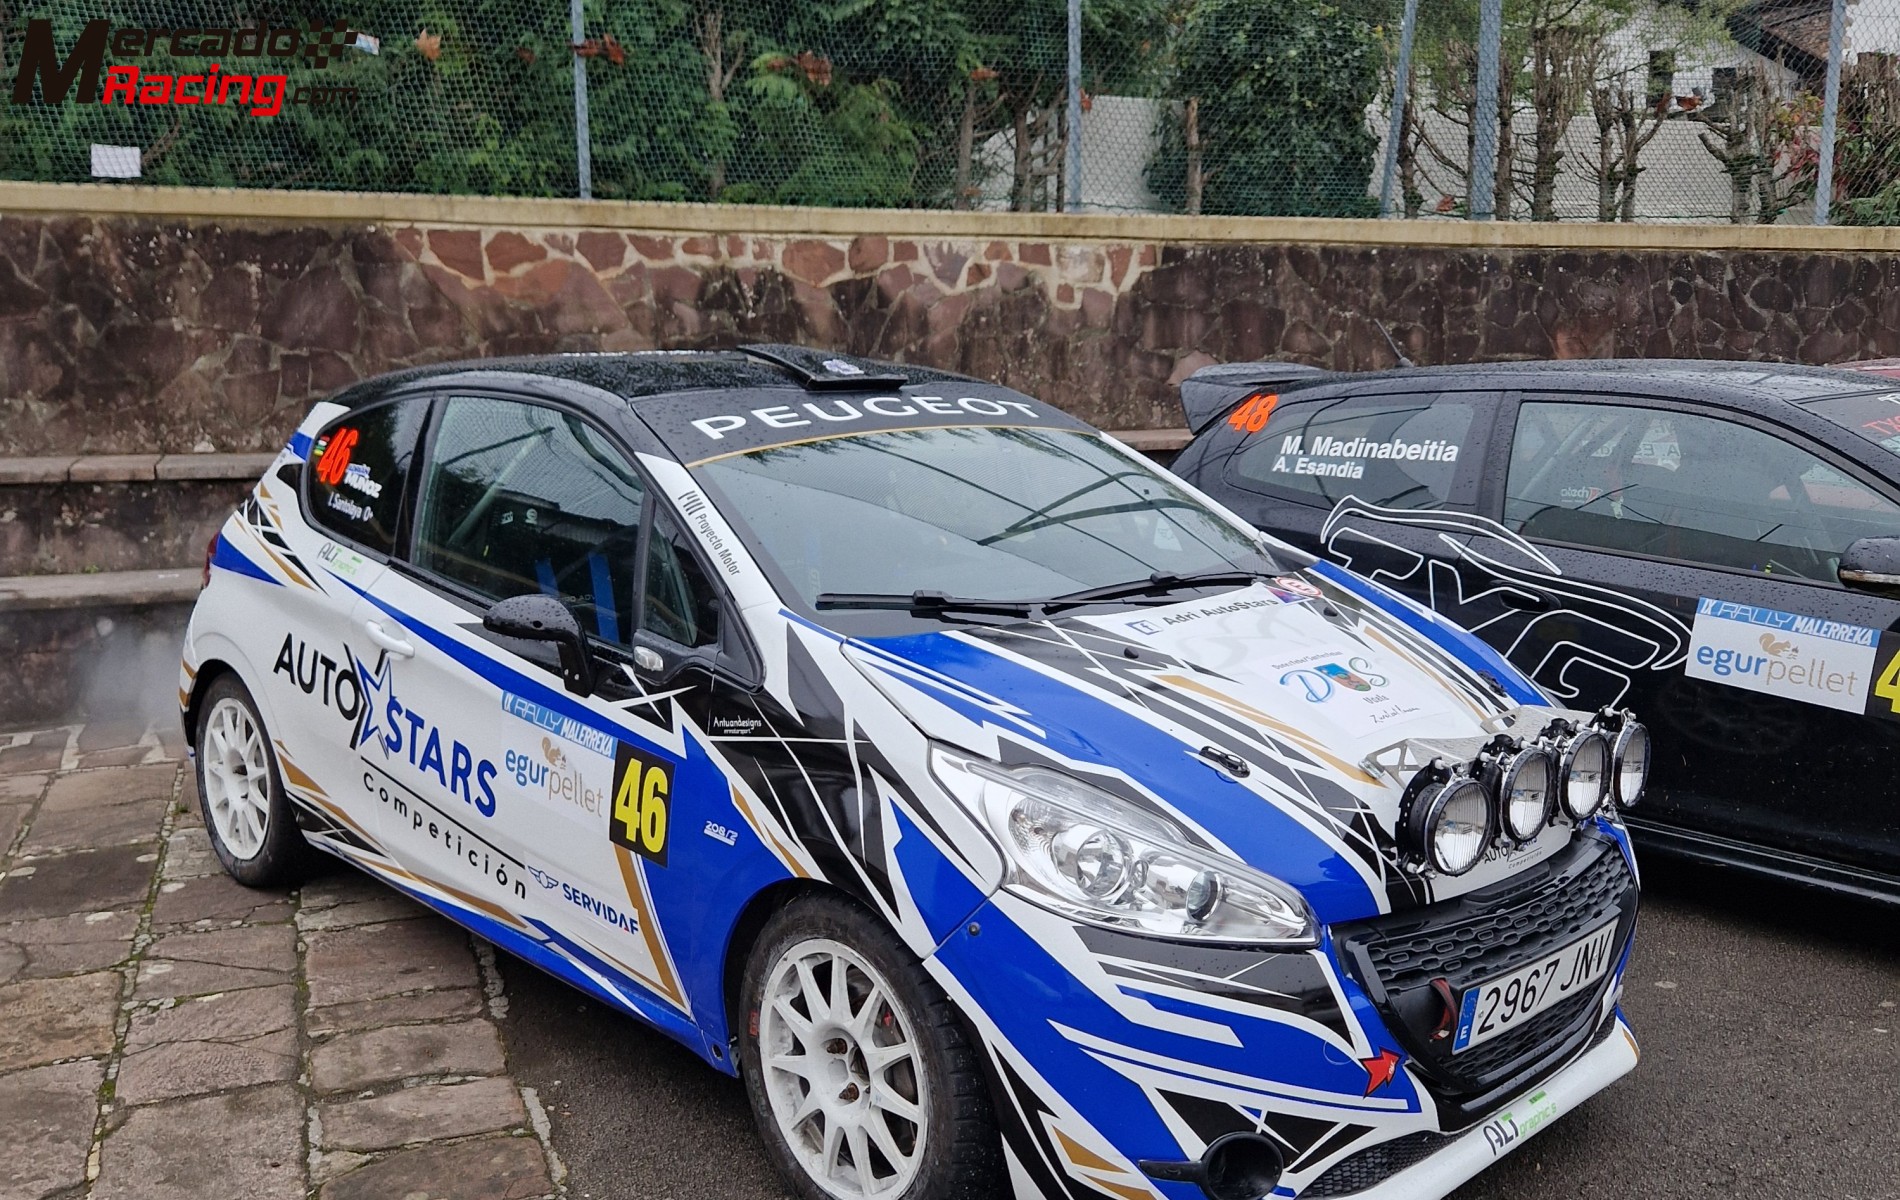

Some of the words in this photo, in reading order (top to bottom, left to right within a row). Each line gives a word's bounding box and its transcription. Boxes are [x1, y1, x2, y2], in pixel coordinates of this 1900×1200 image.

[691, 396, 1040, 440] PEUGEOT
[1227, 393, 1279, 433] 48
[316, 427, 359, 487] 46
[1272, 457, 1290, 473] A.
[1294, 457, 1364, 480] Esandia
[1280, 435, 1304, 455] M.
[1310, 436, 1459, 462] Madinabeitia
[695, 513, 724, 551] Proyecto
[718, 548, 741, 576] Motor
[1162, 611, 1199, 626] Adri
[1200, 598, 1278, 617] AutoStars
[1701, 599, 1714, 615] IX
[1717, 601, 1794, 628] RALLY
[1792, 615, 1873, 646] MALERREKA
[1696, 644, 1859, 697] egurpellet
[273, 632, 360, 721] AUTO
[384, 696, 498, 818] STARS
[503, 691, 512, 713] IX
[514, 698, 564, 732] RALLY
[560, 721, 615, 758] MALERREKA
[505, 748, 605, 818] egurpellet
[614, 757, 669, 854] 46
[363, 771, 527, 900] Competición
[562, 882, 639, 936] SERVIDAF
[1477, 958, 1560, 1037] 2967
[1560, 927, 1615, 993] JNV
[1459, 1026, 1468, 1041] E
